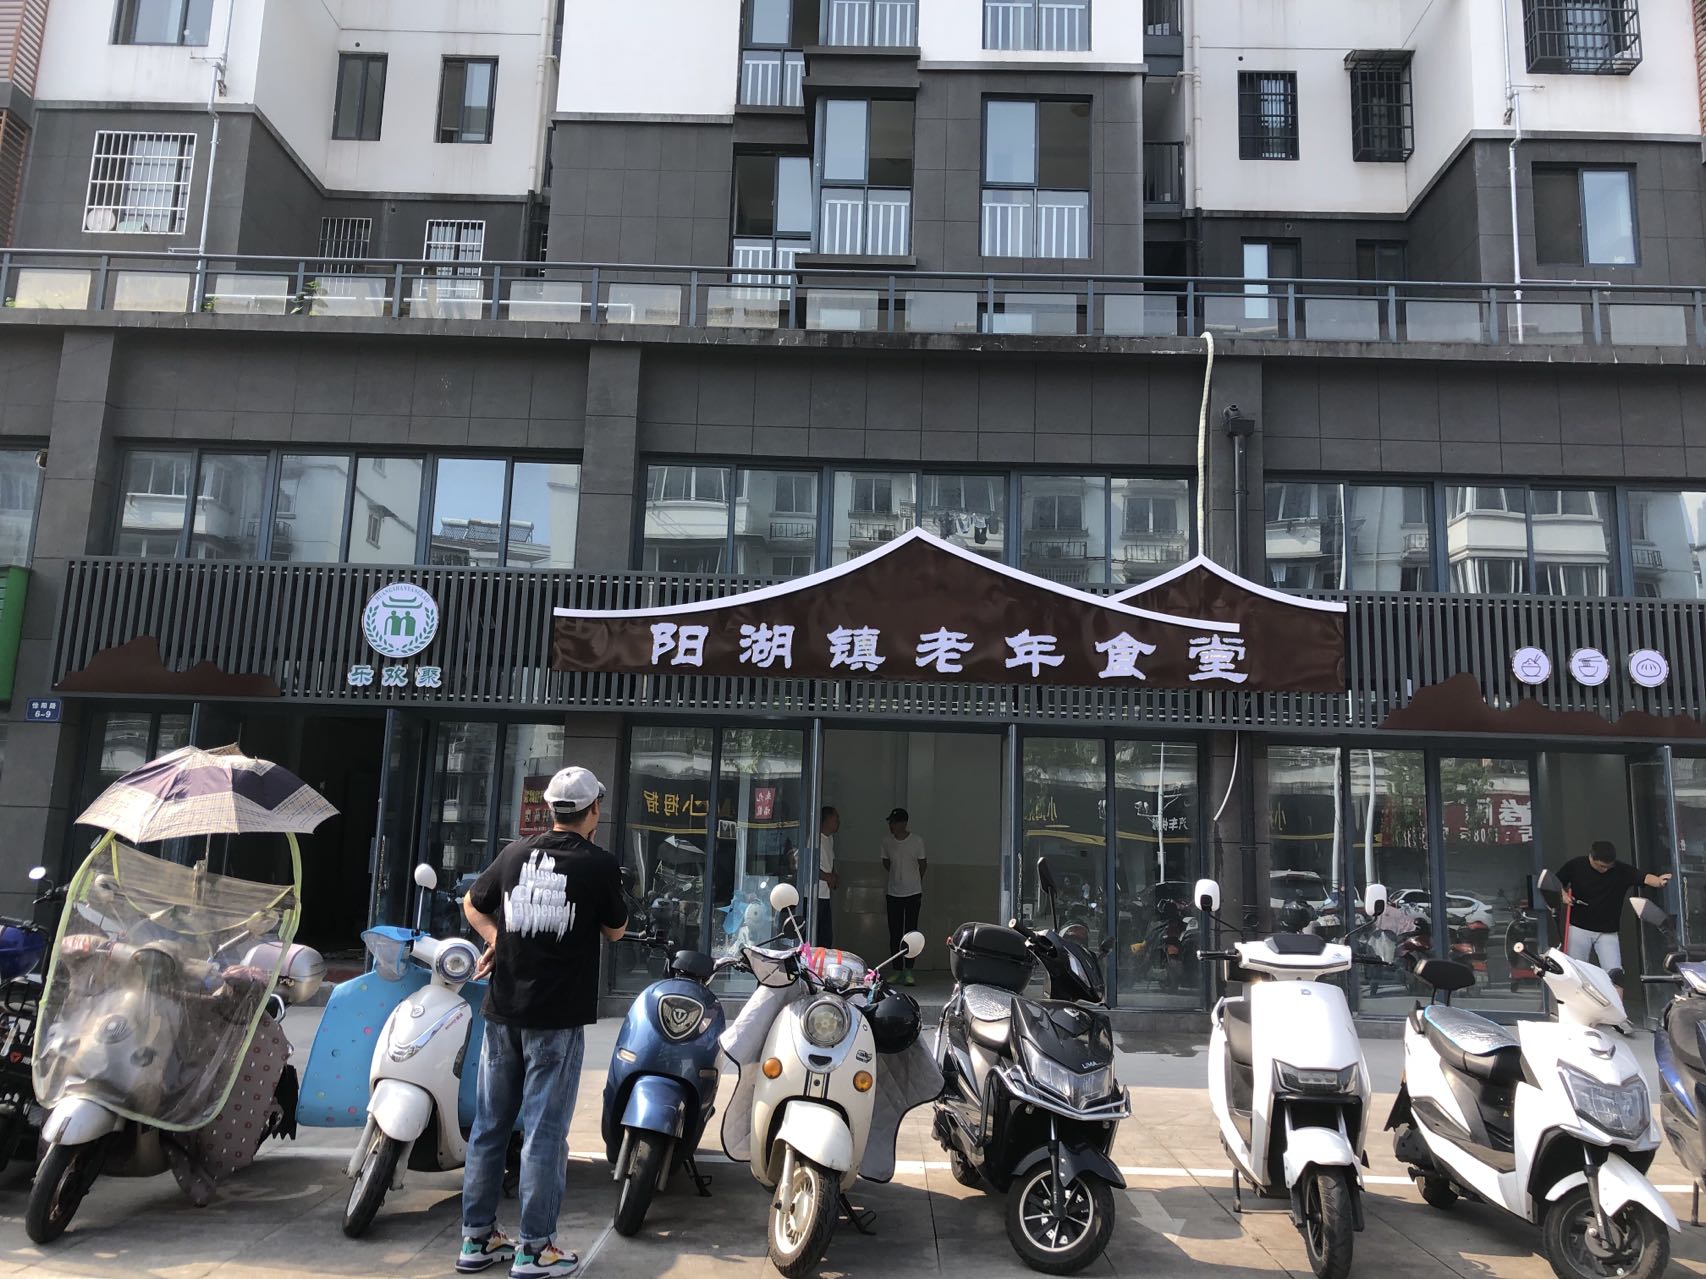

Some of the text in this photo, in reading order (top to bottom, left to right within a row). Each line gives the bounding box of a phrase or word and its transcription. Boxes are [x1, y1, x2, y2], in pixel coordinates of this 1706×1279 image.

[650, 622, 1248, 684] 阳湖镇老年食堂
[347, 664, 442, 688] 乐欢聚
